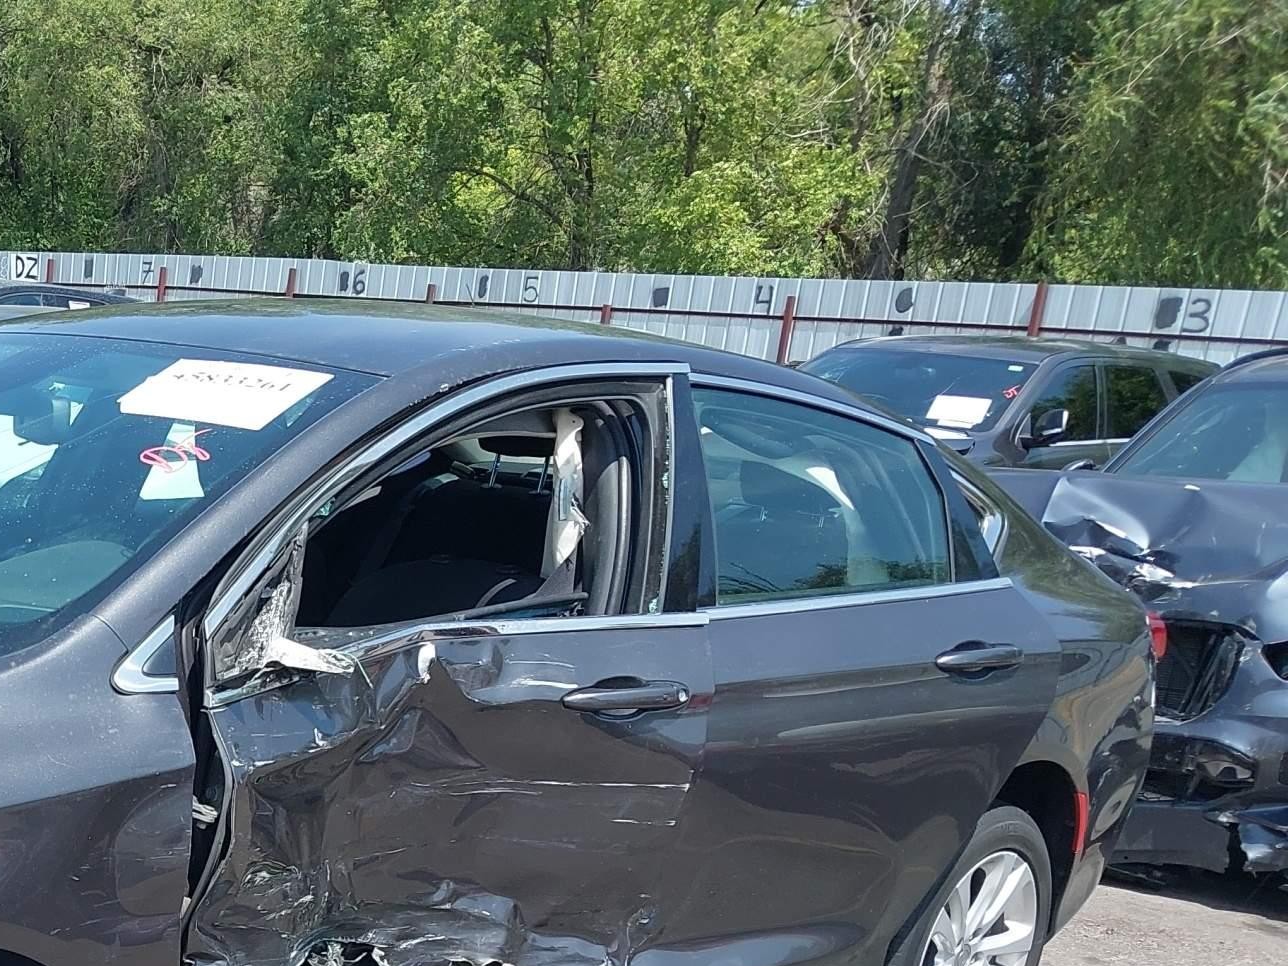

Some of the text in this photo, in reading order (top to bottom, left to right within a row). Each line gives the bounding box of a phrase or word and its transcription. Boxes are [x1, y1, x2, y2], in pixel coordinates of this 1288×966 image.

[15, 255, 39, 280] DZ
[142, 261, 154, 284] 7
[351, 269, 366, 295] 6
[523, 276, 539, 302] 5
[754, 285, 771, 314] 4
[1182, 299, 1212, 332] 3
